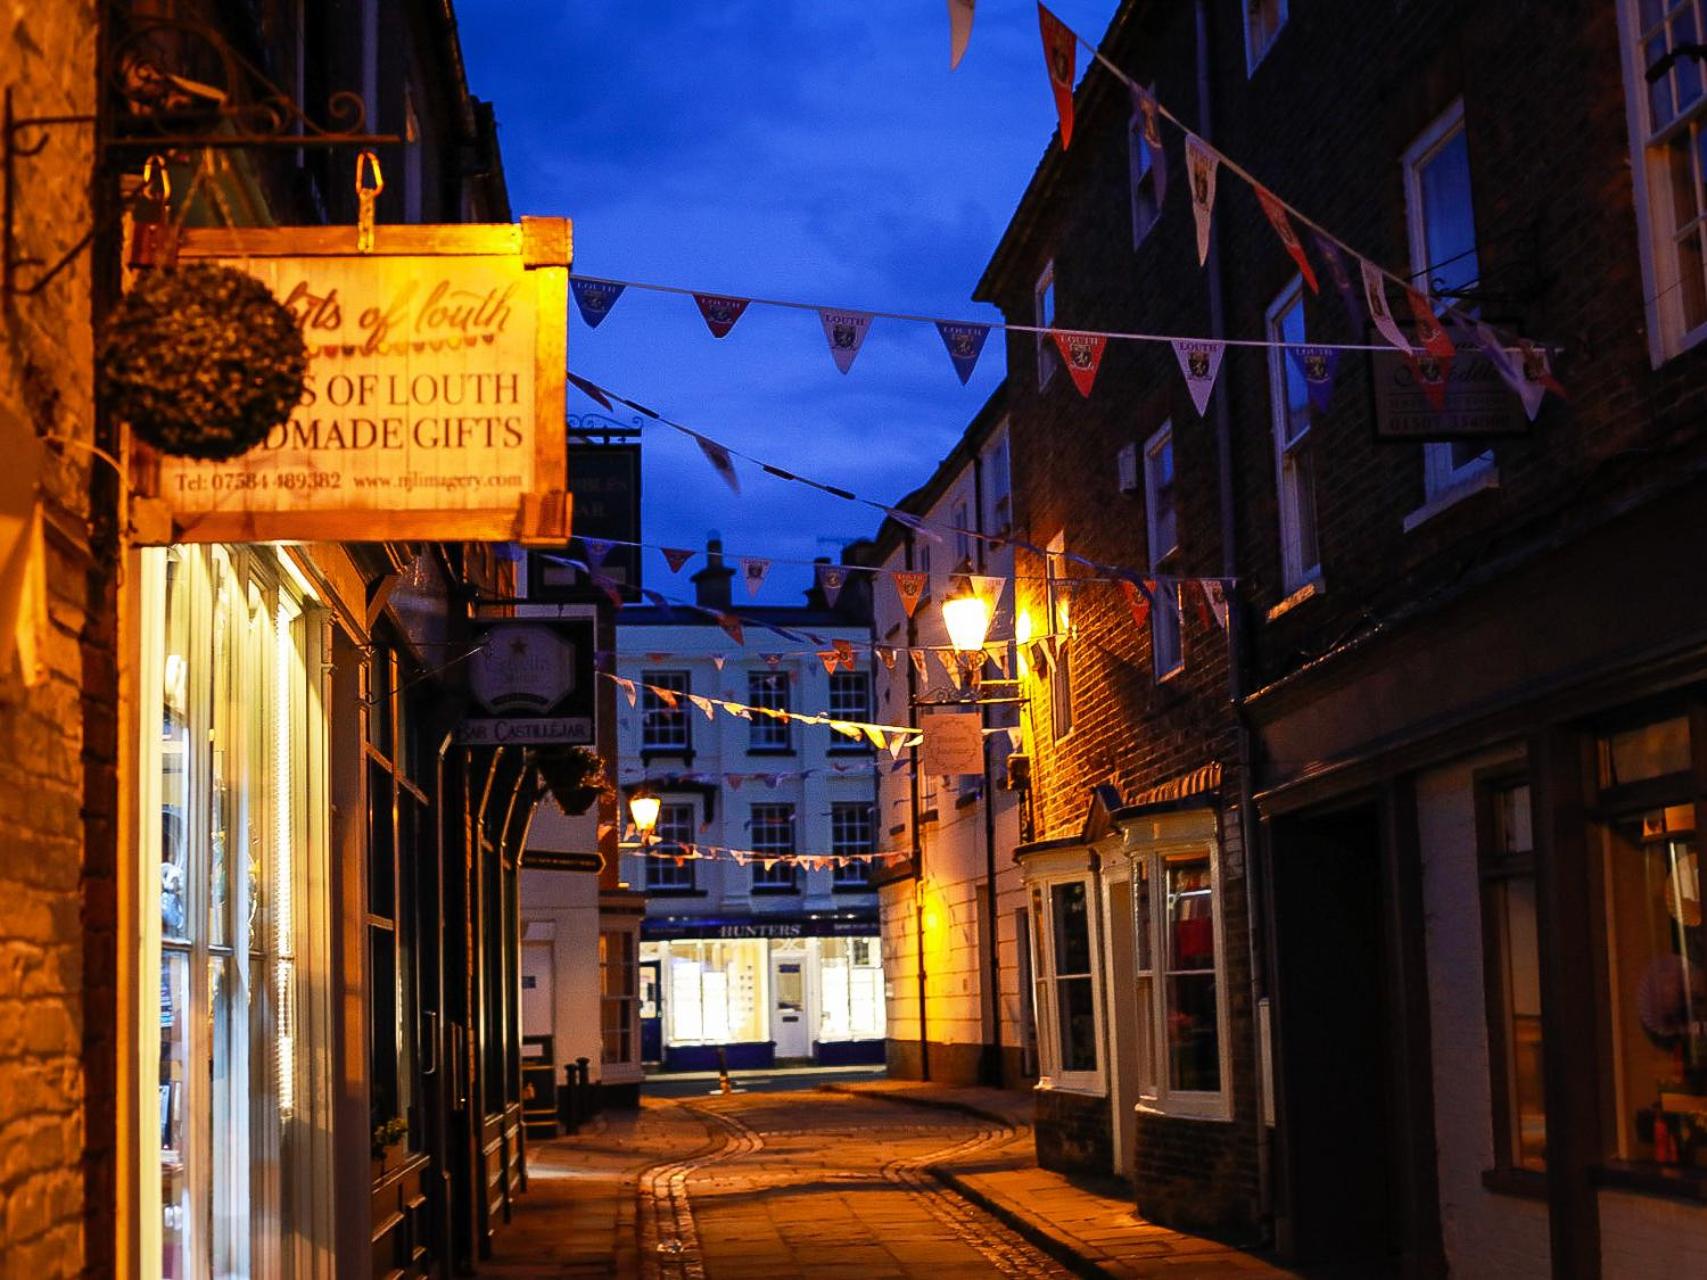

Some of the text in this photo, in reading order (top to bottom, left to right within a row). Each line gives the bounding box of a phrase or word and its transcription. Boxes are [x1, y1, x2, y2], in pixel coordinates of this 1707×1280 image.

[358, 280, 421, 350] of
[415, 279, 519, 333] louth
[825, 314, 865, 326] LOUTH
[1060, 335, 1098, 345] LOUTH
[1179, 342, 1218, 351] LOUTH
[327, 374, 378, 407] OF
[388, 373, 519, 406] LOUTH
[263, 416, 523, 451] DMADE GIFTS
[176, 473, 208, 491] Tel:
[720, 924, 802, 937] HUNTERS
